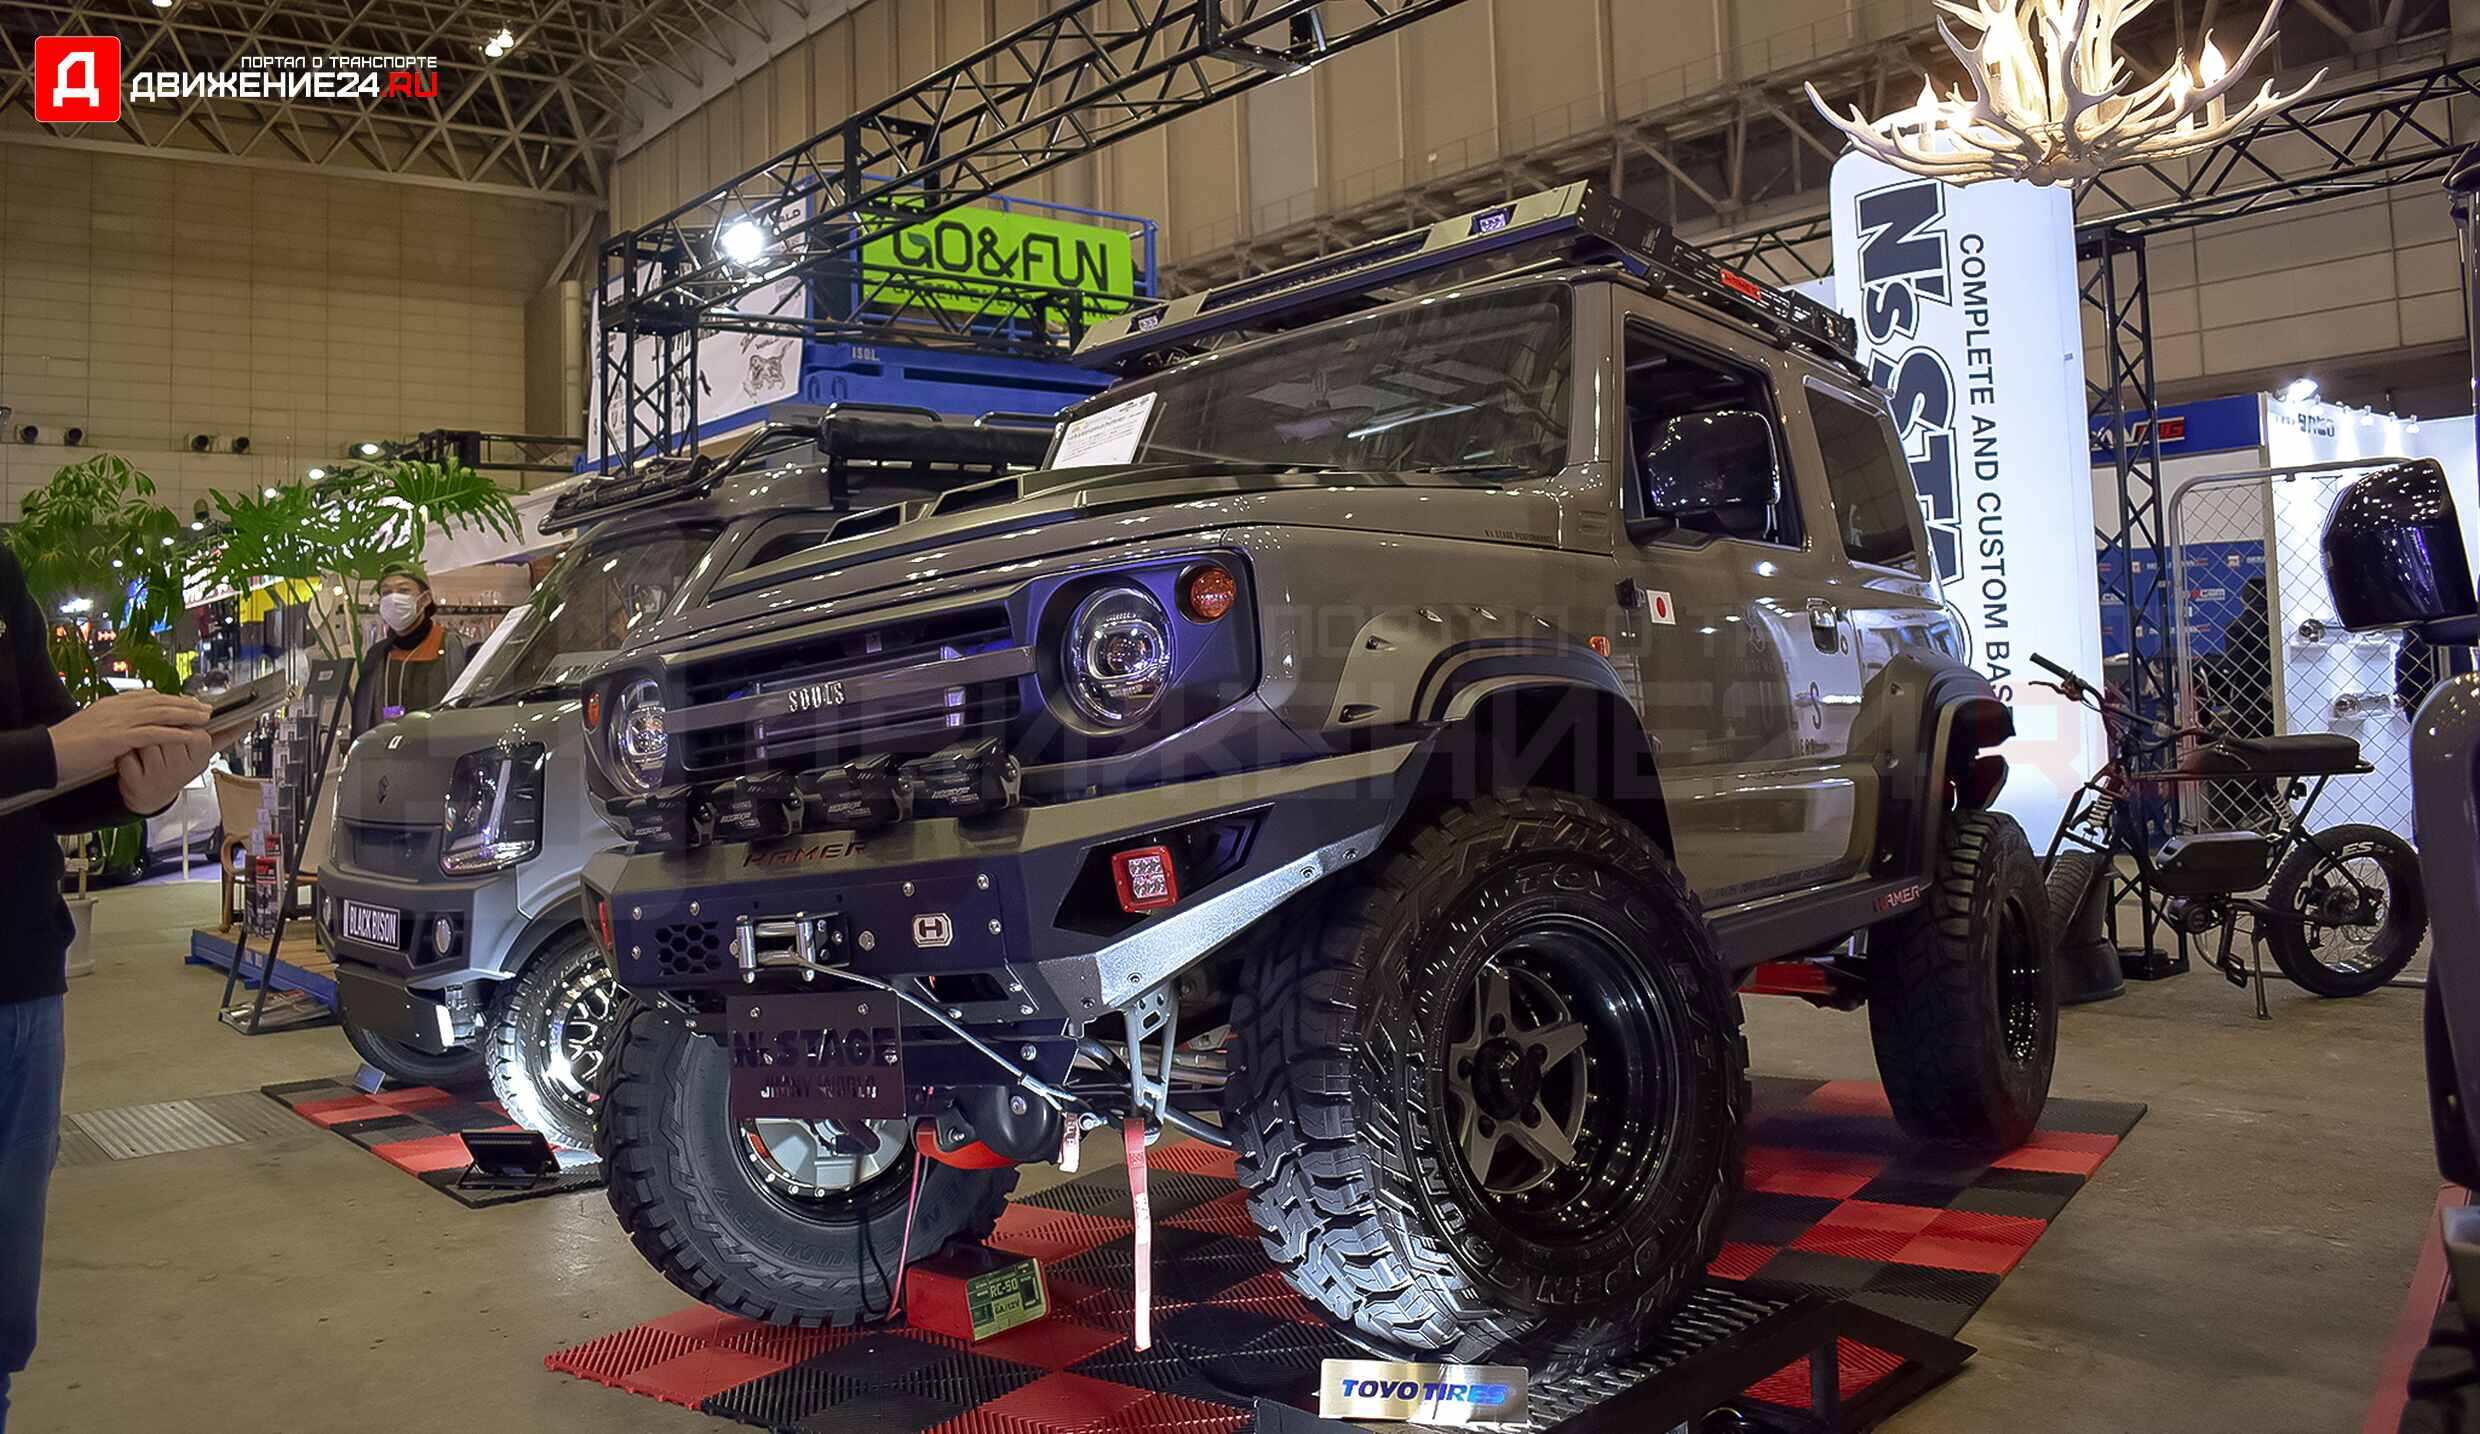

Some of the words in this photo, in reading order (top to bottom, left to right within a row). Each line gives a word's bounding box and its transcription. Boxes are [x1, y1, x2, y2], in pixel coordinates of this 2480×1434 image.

[893, 220, 1110, 292] GO&FUN
[1959, 233, 1996, 405] COMPLETE
[1971, 415, 1999, 482] AND
[1976, 492, 2009, 629] CUSTOM
[1985, 641, 2014, 722] BAS
[349, 905, 372, 939] BLACK
[372, 910, 396, 945] BISON
[990, 1278, 1019, 1297] RC-50
[1342, 1379, 1419, 1400] TOYO
[1422, 1382, 1507, 1404] TIRES
